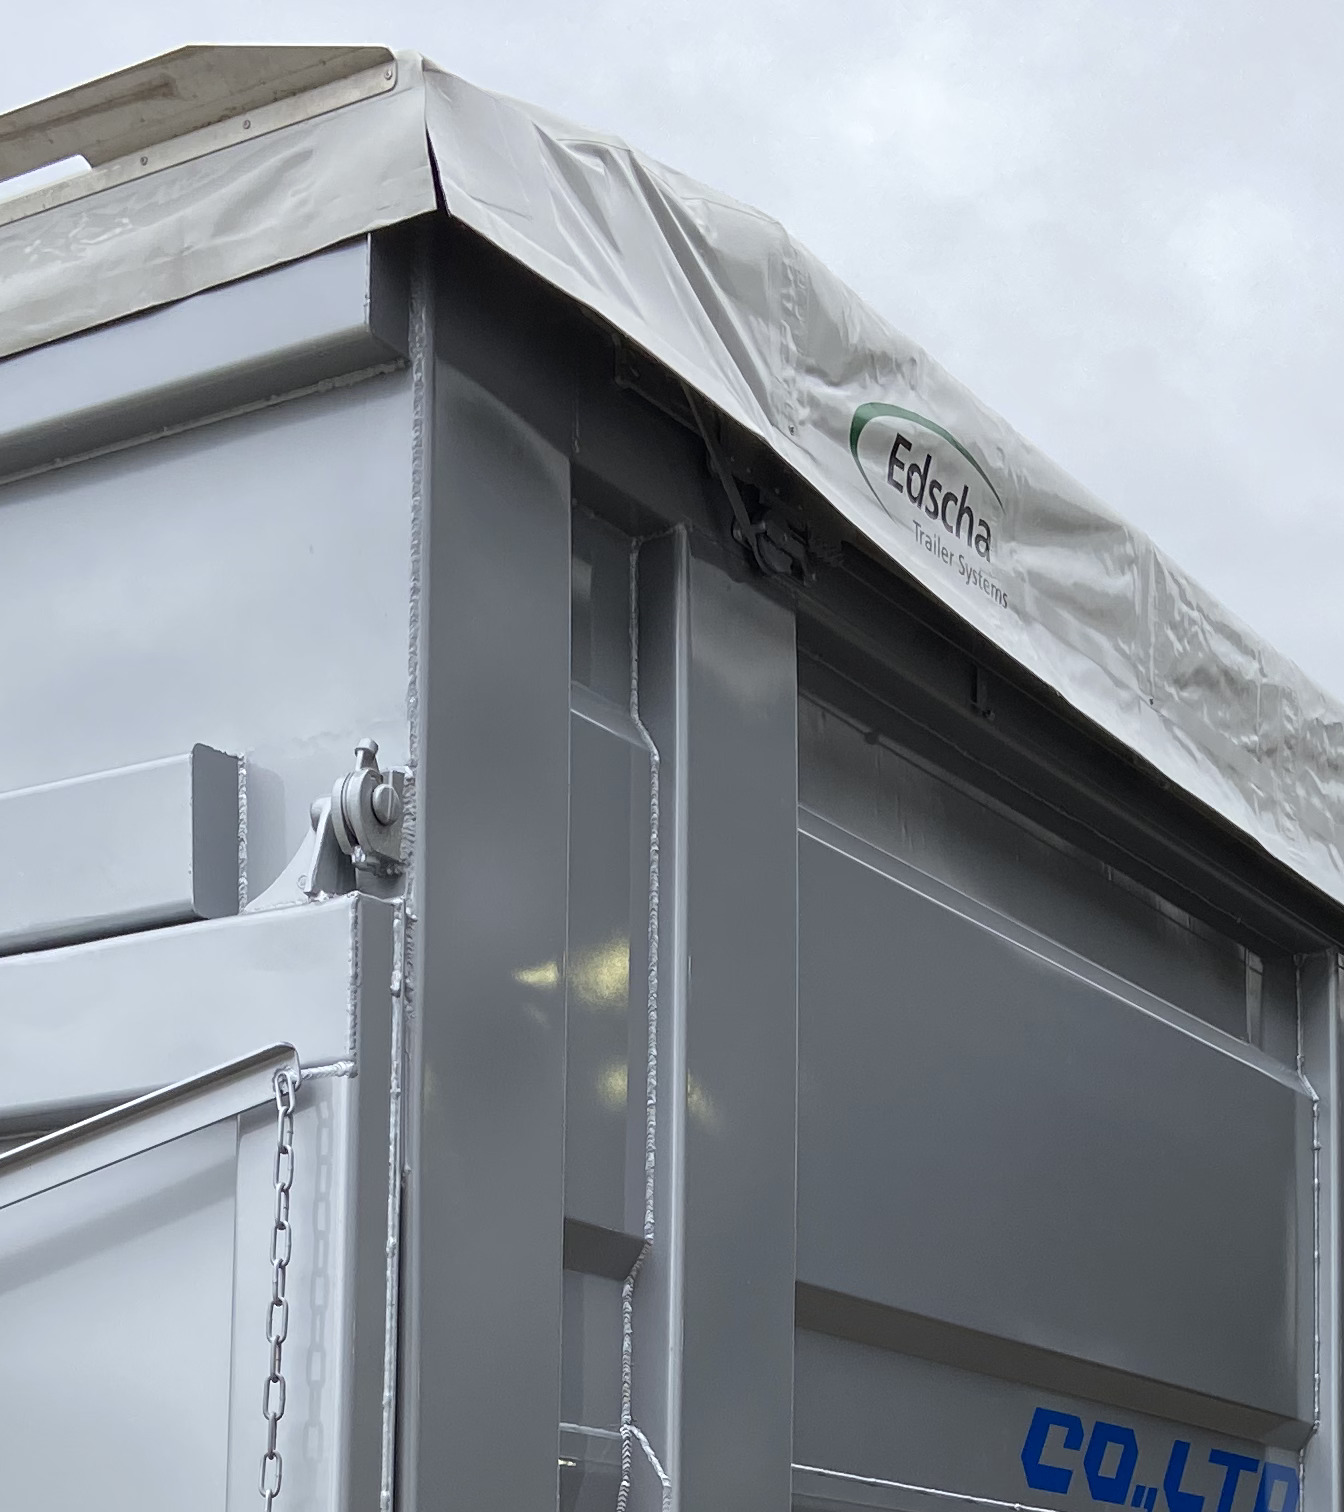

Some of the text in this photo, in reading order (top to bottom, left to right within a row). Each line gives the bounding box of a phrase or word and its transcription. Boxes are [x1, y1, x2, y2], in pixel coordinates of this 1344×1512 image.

[887, 432, 992, 563] Edscha
[912, 519, 1008, 610] Trailer Systems
